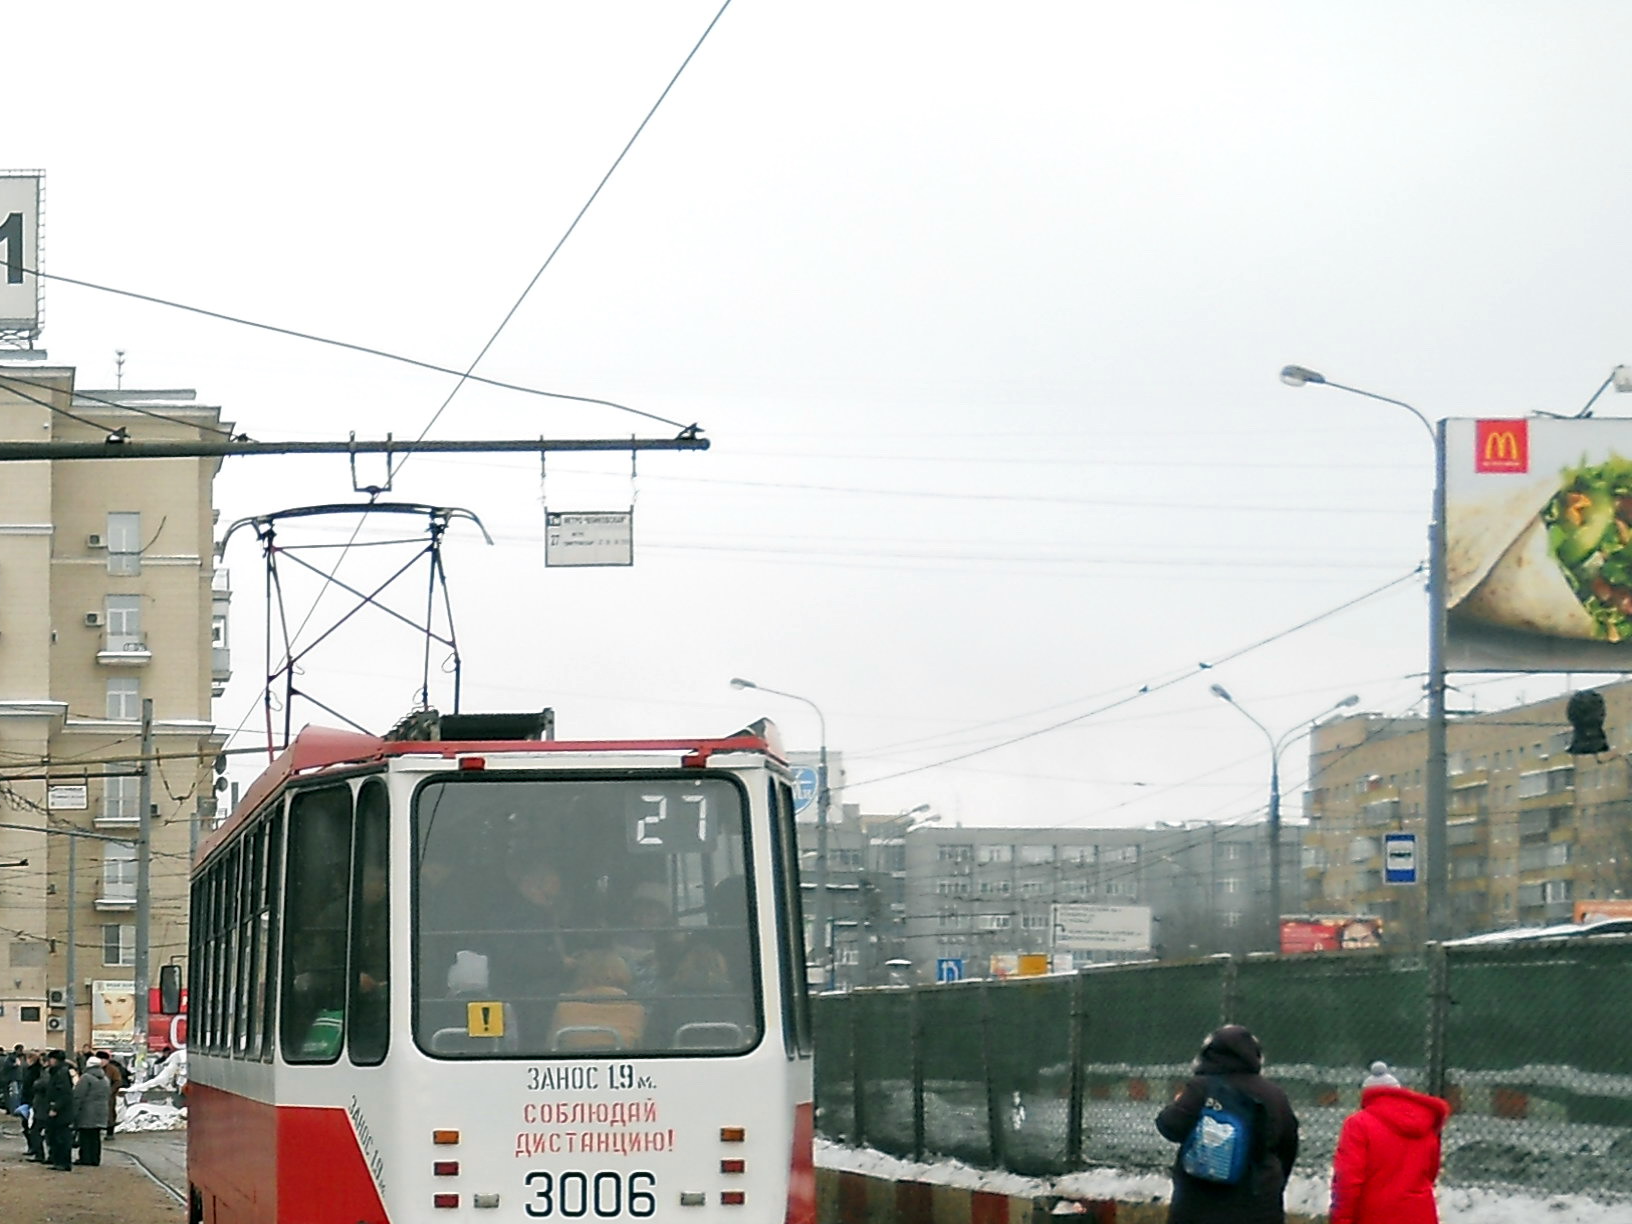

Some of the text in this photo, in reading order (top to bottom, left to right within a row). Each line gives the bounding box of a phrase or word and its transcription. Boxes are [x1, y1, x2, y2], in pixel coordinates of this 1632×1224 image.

[637, 794, 706, 844] 27
[527, 1067, 599, 1090] ЗАНОС
[524, 1098, 657, 1127] СОБЛЮДАЙ
[515, 1129, 673, 1158] ДИСТАНЦИЮ!
[524, 1171, 656, 1218] 3006
